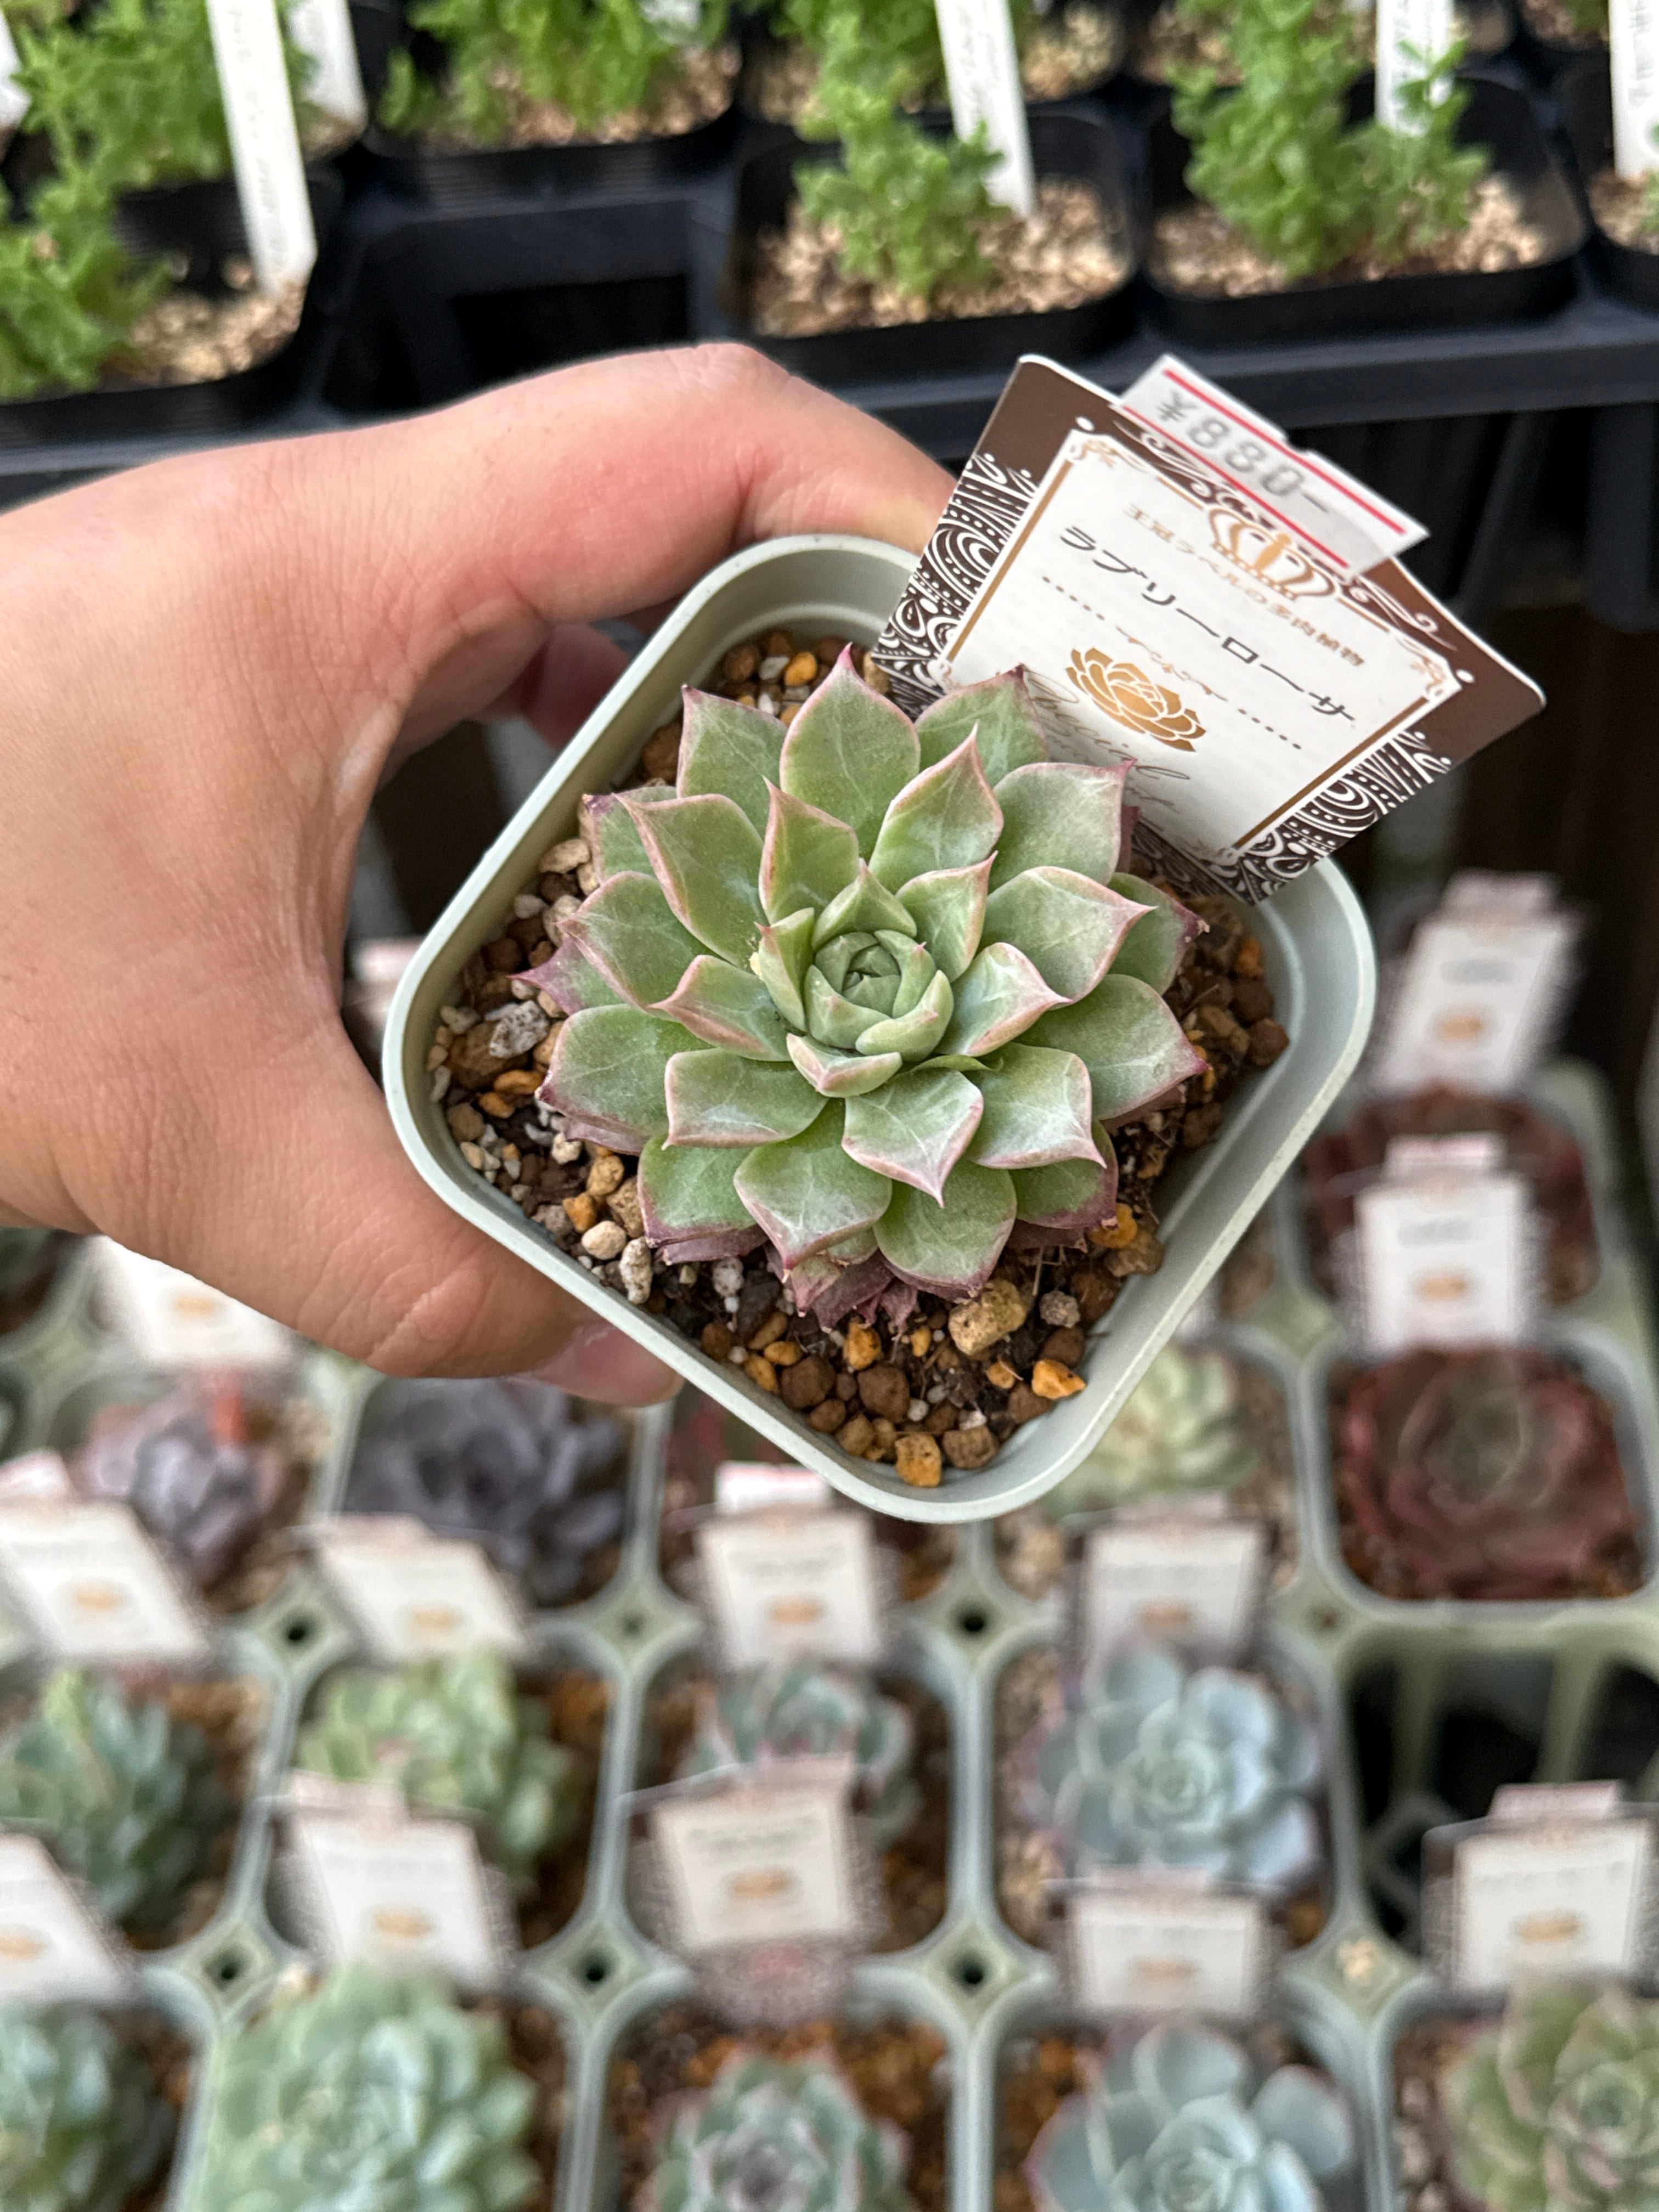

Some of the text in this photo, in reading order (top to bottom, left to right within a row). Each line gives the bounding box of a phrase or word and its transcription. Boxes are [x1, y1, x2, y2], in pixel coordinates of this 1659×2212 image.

[1060, 525, 1355, 721] ラブリーローサ
